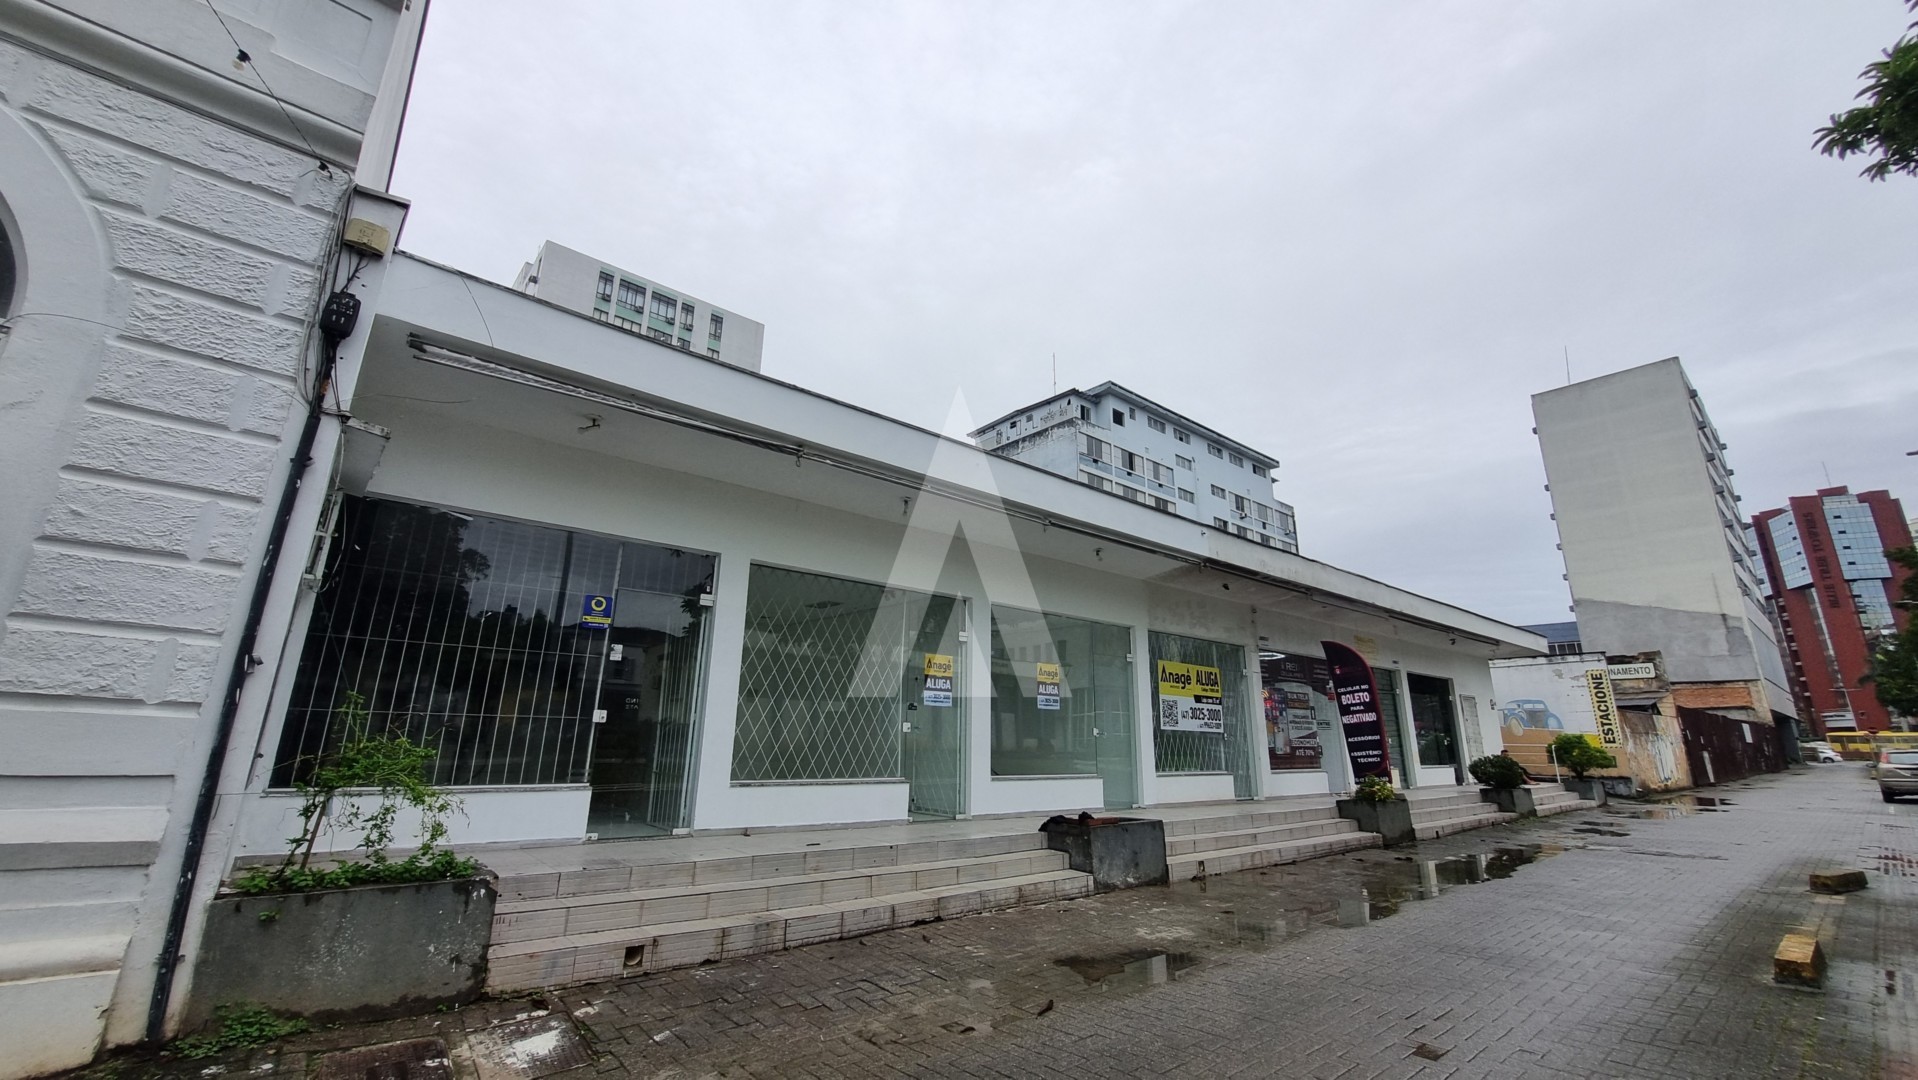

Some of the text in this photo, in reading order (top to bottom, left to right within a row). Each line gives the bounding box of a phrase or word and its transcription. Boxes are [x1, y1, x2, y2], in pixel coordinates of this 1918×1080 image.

[1608, 666, 1651, 676] NAMENTO
[926, 677, 951, 689] ALUGA
[1196, 670, 1219, 687] ALUGA
[1038, 684, 1059, 694] ALUGA
[1337, 685, 1360, 693] CELULAR
[1341, 692, 1370, 705] BOLETO
[1181, 707, 1222, 721] (47) 3025-3000
[1591, 673, 1616, 744] ESTACIONE
[1341, 711, 1377, 725] NEGATIVADO
